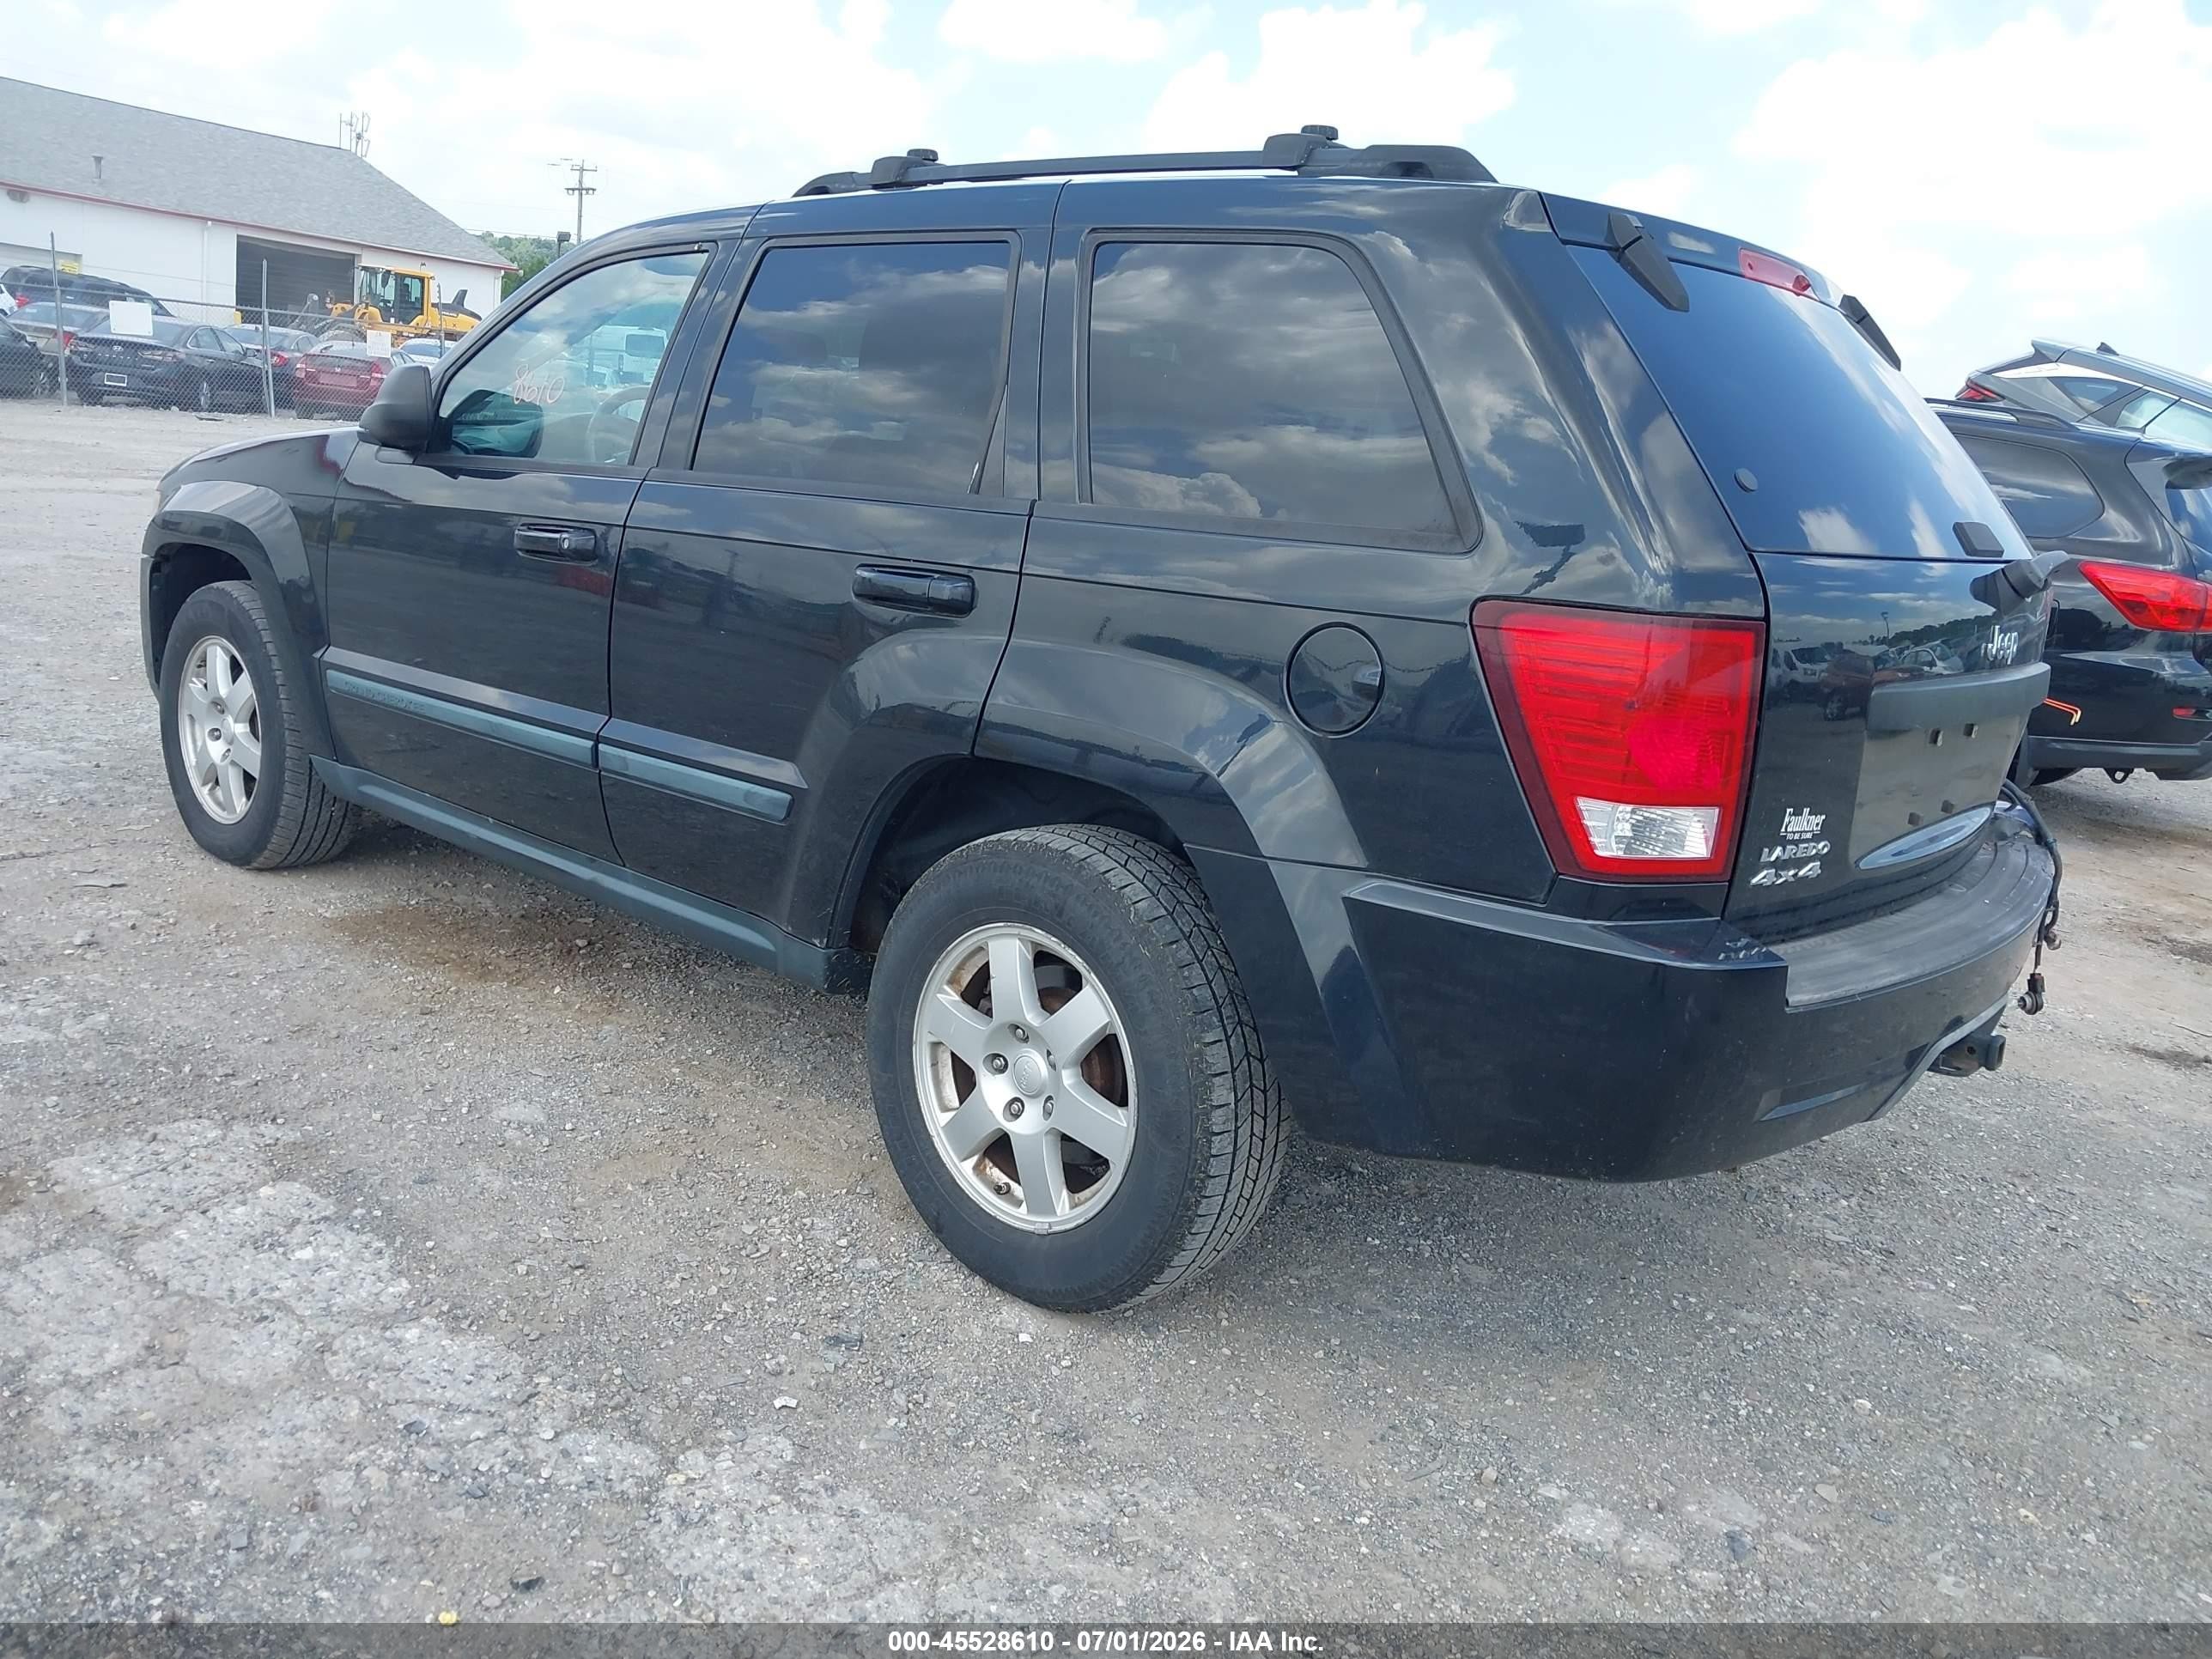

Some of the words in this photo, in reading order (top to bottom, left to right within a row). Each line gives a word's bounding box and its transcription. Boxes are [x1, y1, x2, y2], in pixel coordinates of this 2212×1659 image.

[513, 363, 566, 405] 8610
[1983, 625, 2019, 665] Jeep
[1780, 807, 1826, 832] Faulkner
[1759, 841, 1831, 862] LAREDO
